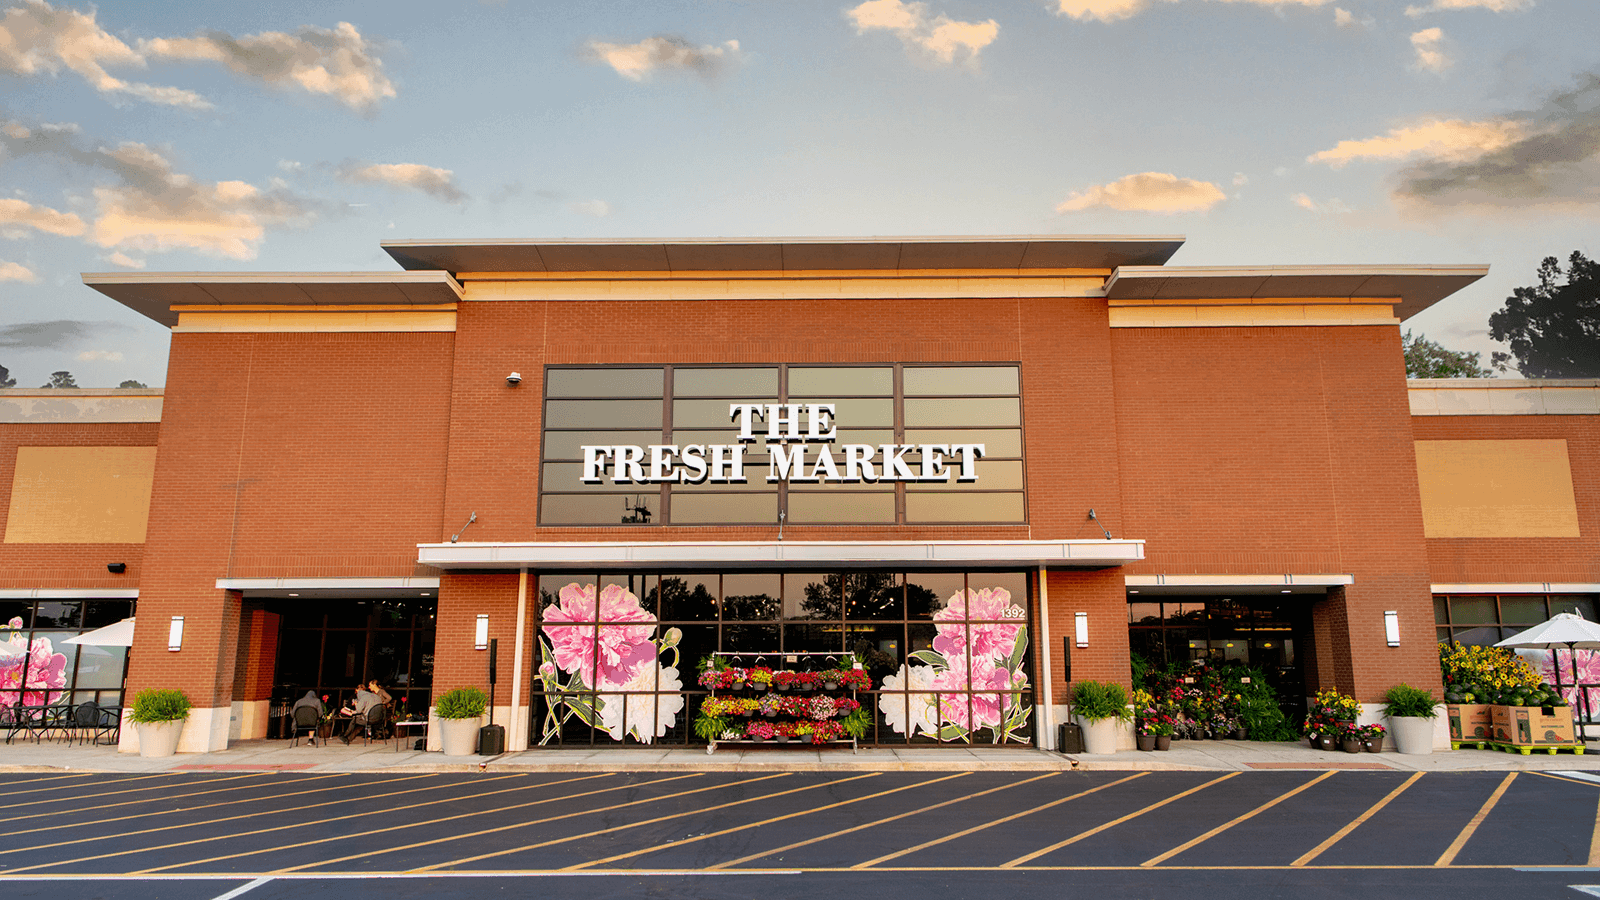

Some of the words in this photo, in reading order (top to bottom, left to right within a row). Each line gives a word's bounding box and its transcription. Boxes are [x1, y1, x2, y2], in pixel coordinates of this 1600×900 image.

[729, 403, 838, 440] THE
[579, 444, 748, 482] FRESH
[765, 443, 987, 482] MARKET
[1001, 608, 1026, 618] 1392
